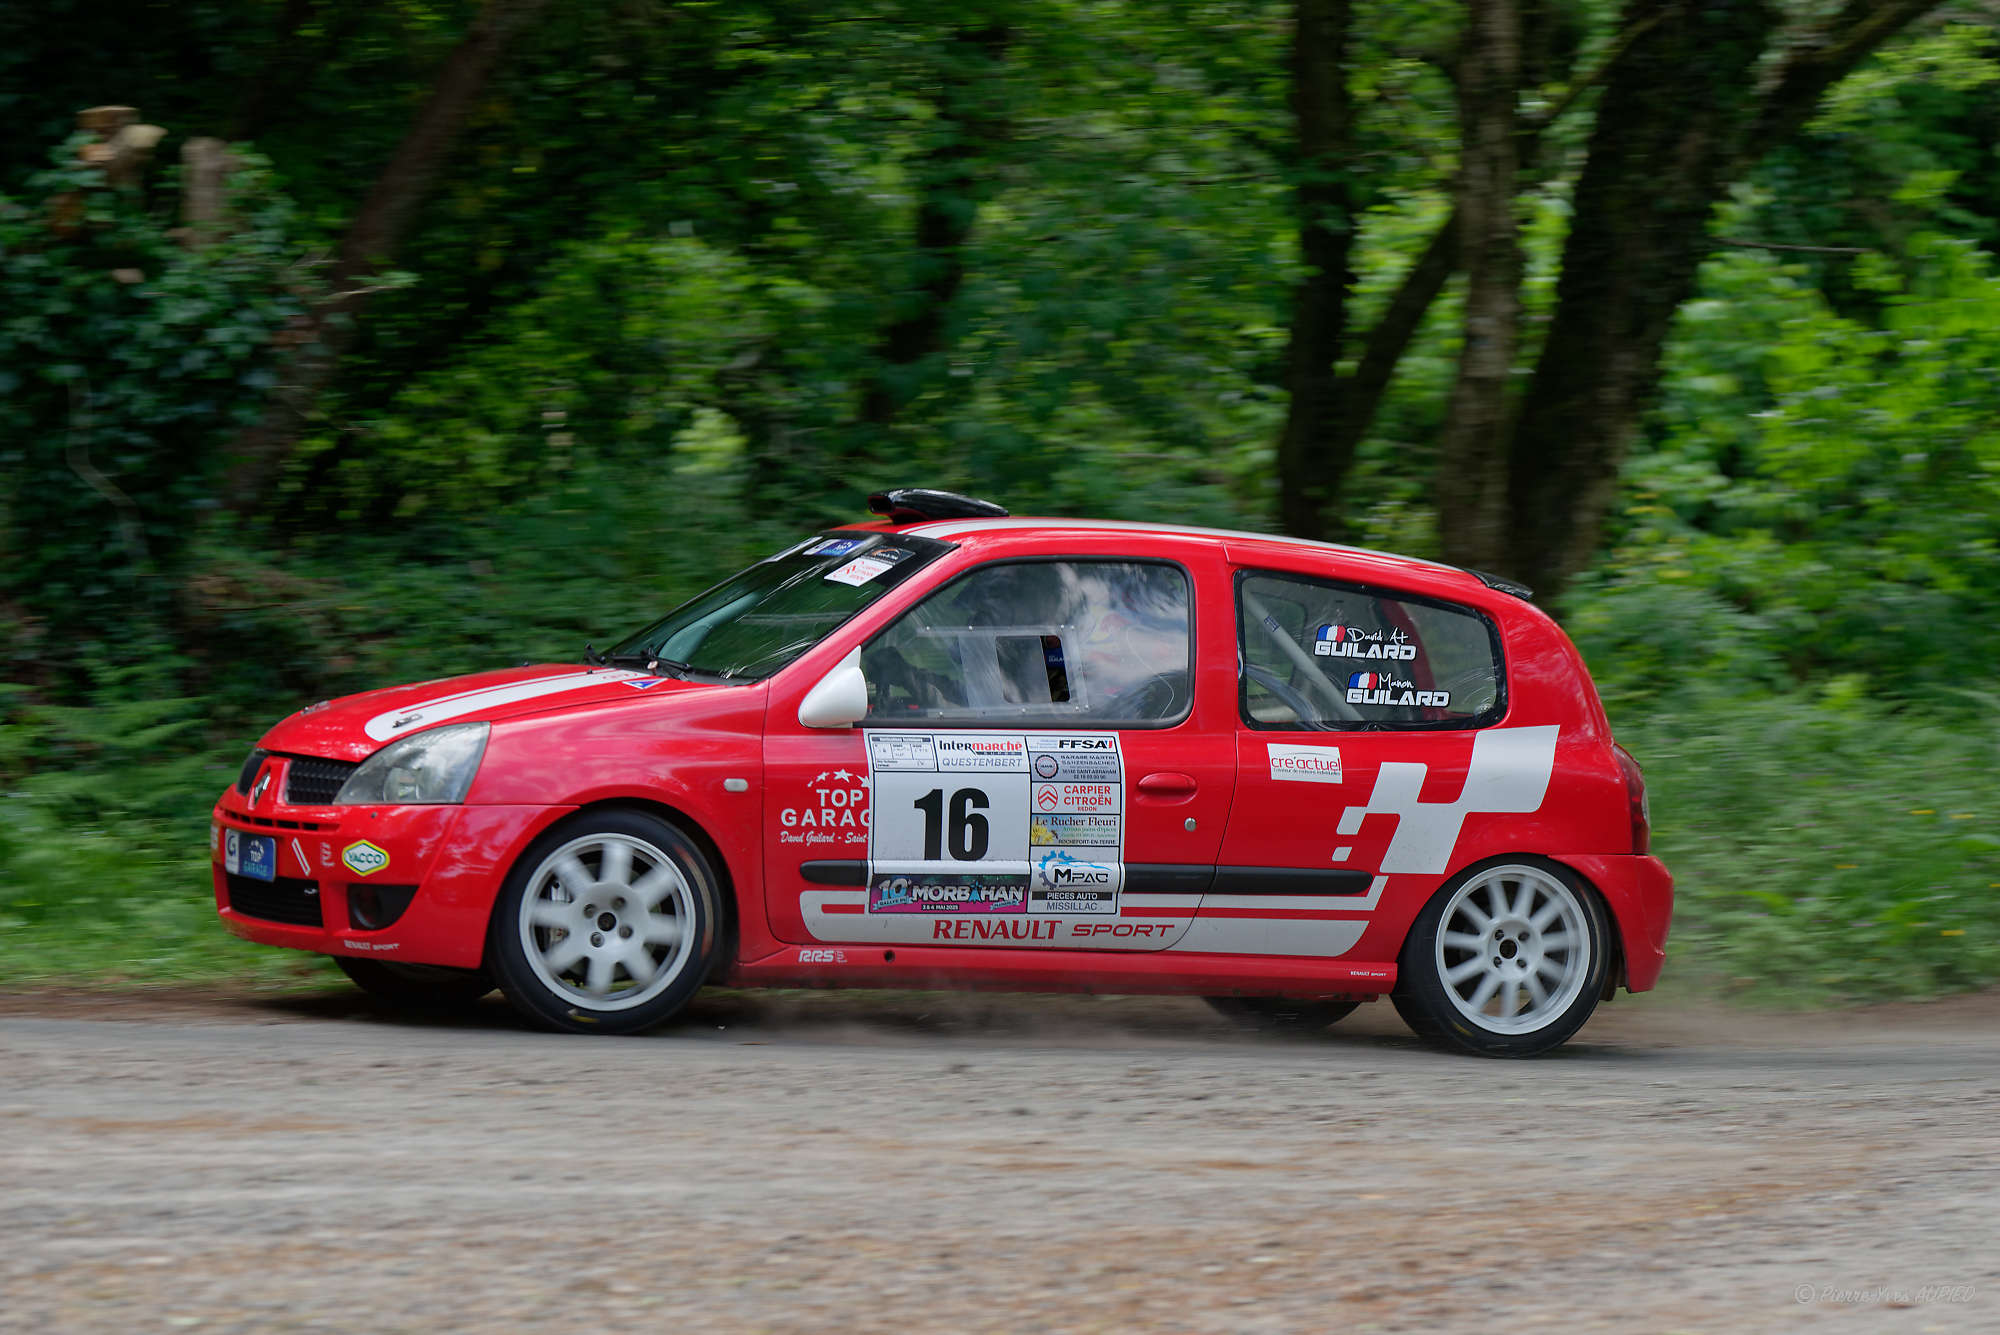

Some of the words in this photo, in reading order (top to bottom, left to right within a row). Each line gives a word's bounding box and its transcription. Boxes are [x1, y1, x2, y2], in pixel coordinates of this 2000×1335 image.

[1347, 627, 1383, 642] David
[1314, 641, 1417, 660] GUILARD
[1379, 672, 1415, 690] Manon
[1346, 688, 1450, 706] GUILARD
[939, 740, 1023, 751] Intermarché
[1058, 740, 1108, 749] FFSA
[942, 757, 1023, 767] QUESTEMBERT
[1063, 785, 1111, 794] CARPIER
[816, 789, 864, 808] TOP
[1063, 795, 1112, 806] CITROËN
[781, 808, 869, 827] GARAG
[914, 787, 990, 861] 16
[1035, 816, 1048, 826] Le
[1050, 816, 1086, 826] Rucher
[1088, 816, 1116, 826] Fleuri
[1054, 868, 1109, 883] MPAC
[1047, 892, 1074, 900] PIECES
[1046, 902, 1098, 910] MISSILLAC
[932, 919, 1063, 940] RENAULT
[1071, 924, 1176, 937] SPORT
